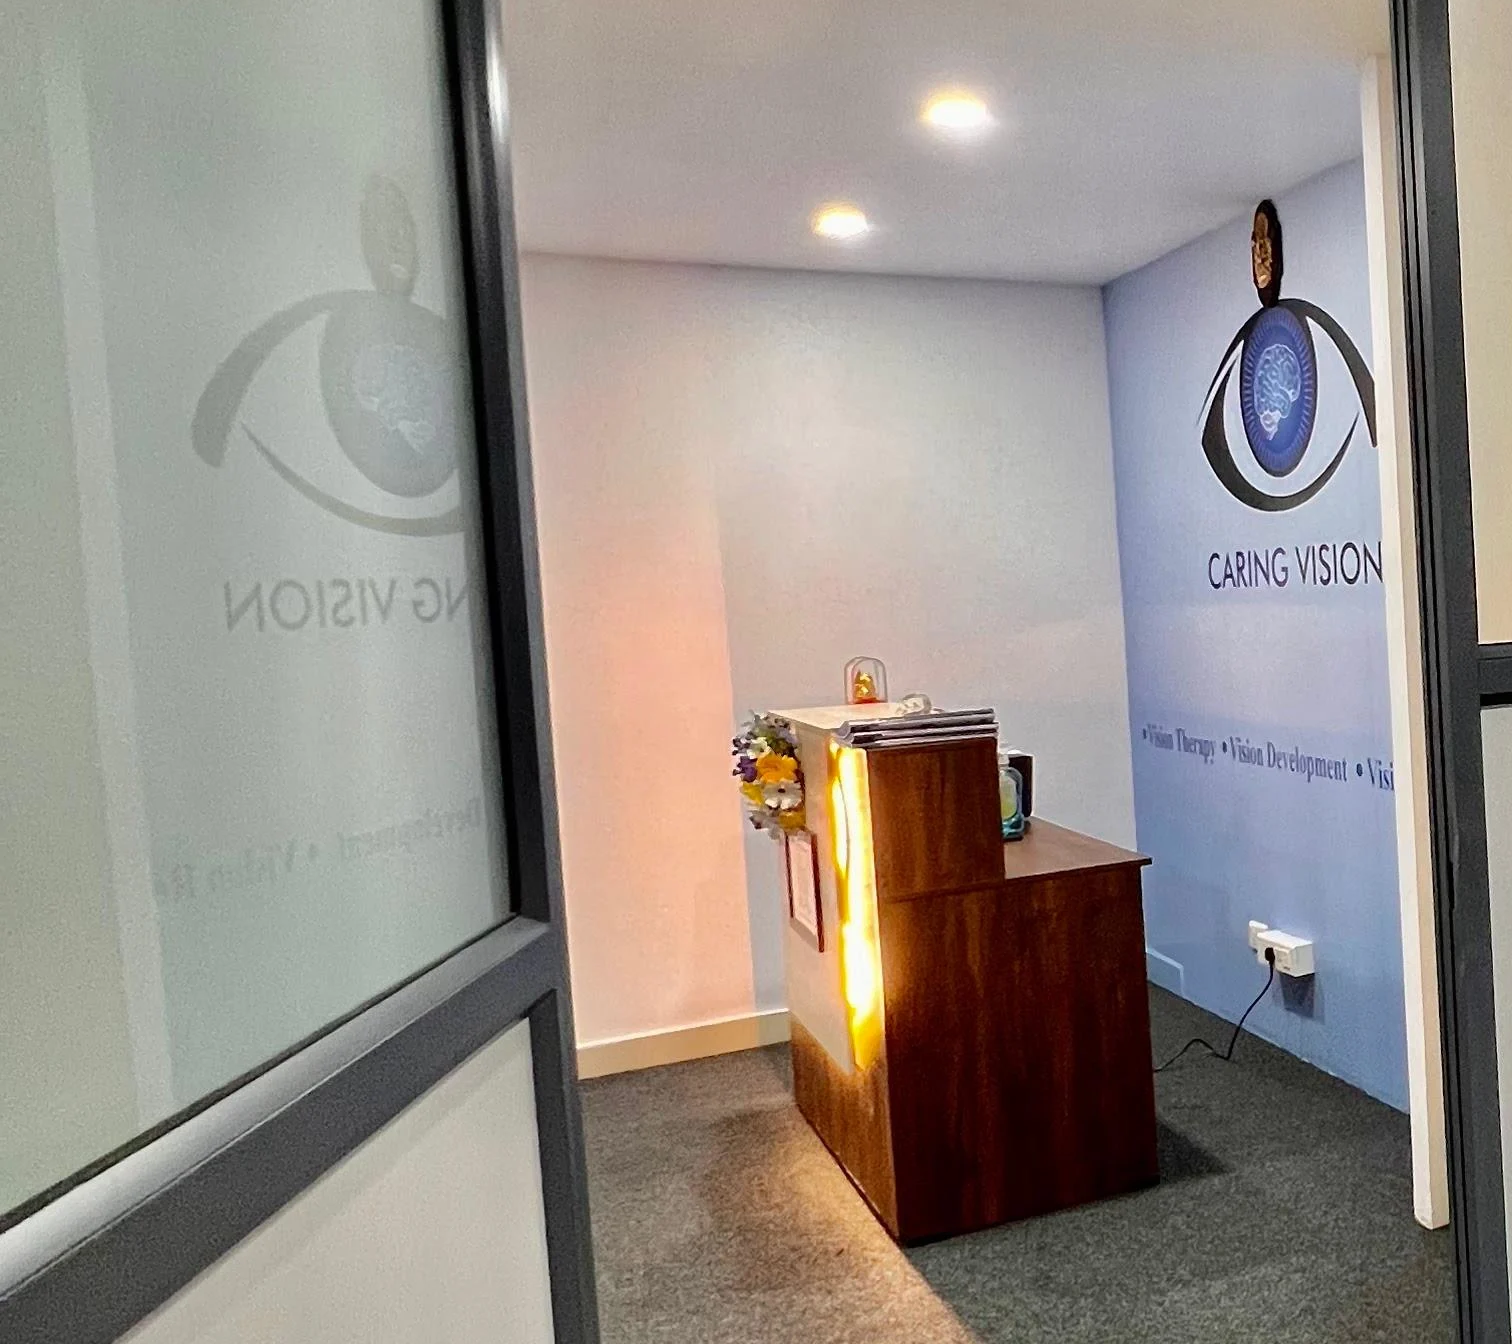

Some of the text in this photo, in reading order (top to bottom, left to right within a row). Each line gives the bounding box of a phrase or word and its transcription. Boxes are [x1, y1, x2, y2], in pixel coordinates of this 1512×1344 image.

[1207, 540, 1384, 590] CARING VISION
[1229, 735, 1265, 767] Vision
[1266, 741, 1349, 784] Development
